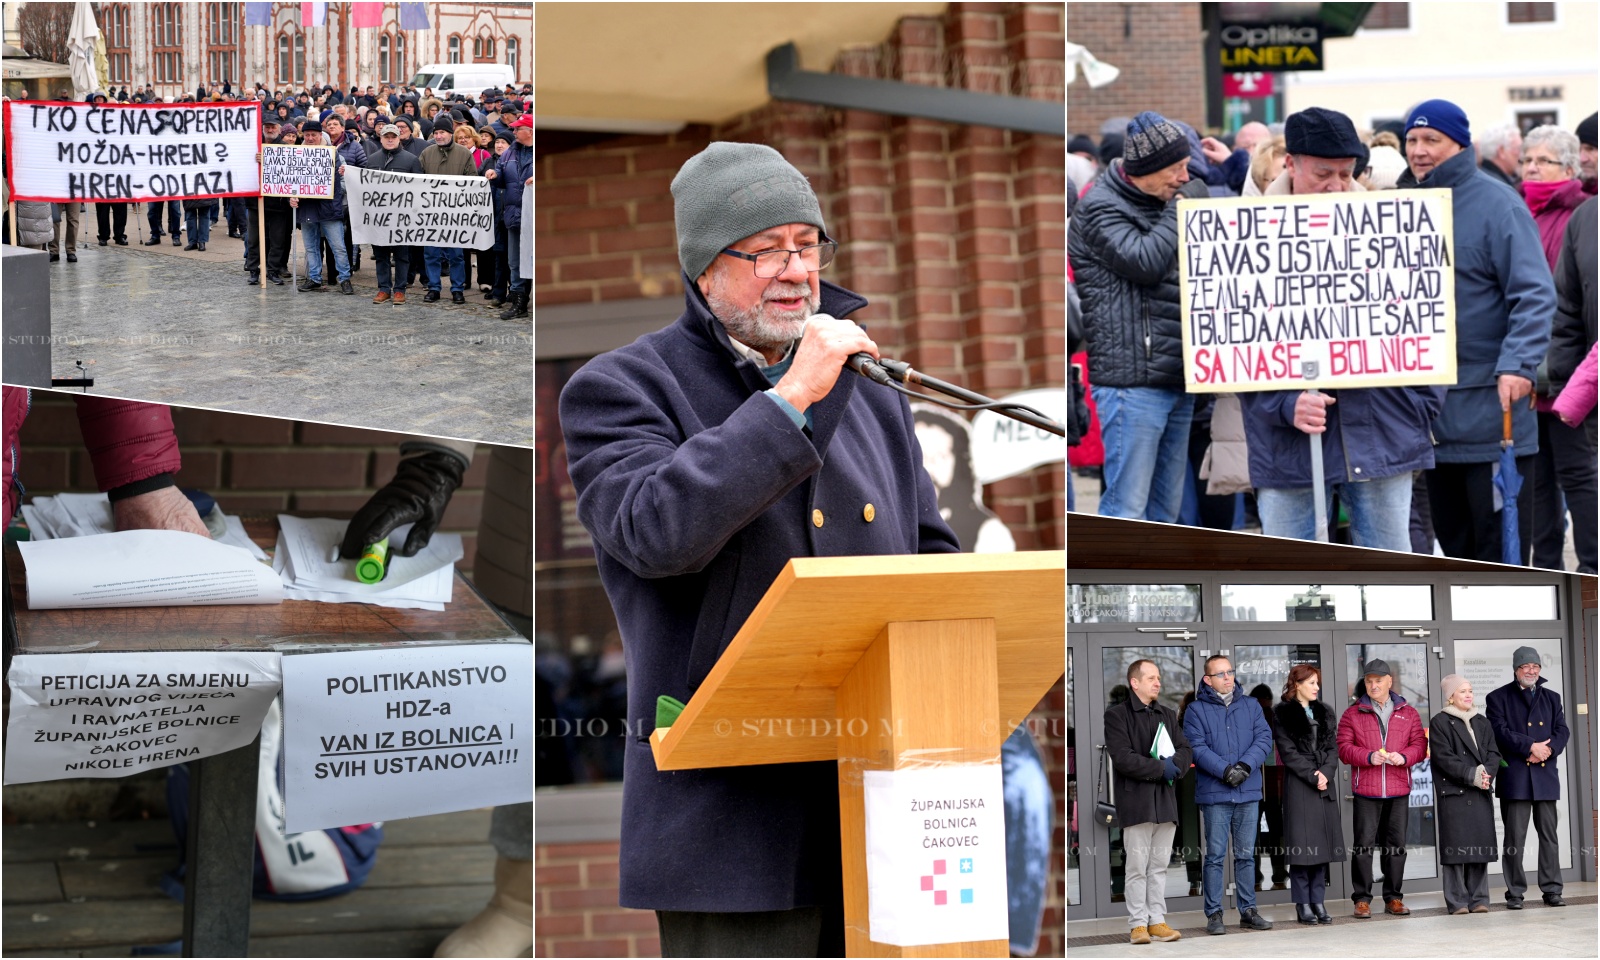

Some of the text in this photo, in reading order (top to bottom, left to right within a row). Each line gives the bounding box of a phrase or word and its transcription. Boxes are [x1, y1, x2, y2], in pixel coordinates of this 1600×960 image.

[1221, 25, 1318, 47] Optika
[1221, 46, 1319, 66] LINETA
[30, 105, 77, 132] TKO
[299, 184, 328, 196] BOLNICE
[362, 189, 491, 208] PREMA STRUČNOSTI
[363, 210, 493, 232] A NE PO STRANAČKOJ
[388, 228, 477, 245] ISKAZNICI
[1278, 236, 1363, 274] OSTAJE
[1194, 335, 1434, 384] SA NAŠE BOLNICE
[993, 418, 1065, 444] MEO
[41, 673, 250, 690] PETICIJA ZA SMJENU
[326, 665, 507, 696] POLITIKANSTVO
[50, 691, 236, 707] UPRAVNOG VIJEĆA
[386, 699, 452, 720] HDZ-a
[71, 704, 206, 726] I RAVNATELJA
[34, 715, 241, 743] ŽUPANIJSKE BOLNICE
[320, 733, 368, 753] VAN
[375, 731, 395, 749] IZ
[402, 724, 503, 747] BOLNICA
[89, 733, 178, 755] ČAKOVEC
[65, 746, 201, 772] NIKOLE HRENA
[314, 748, 519, 779] SVIH USTANOVA!!!
[910, 797, 986, 812] ŽUPANIJSKA
[923, 817, 977, 830] BOLNICA
[922, 835, 979, 849] ČAKOVEC
